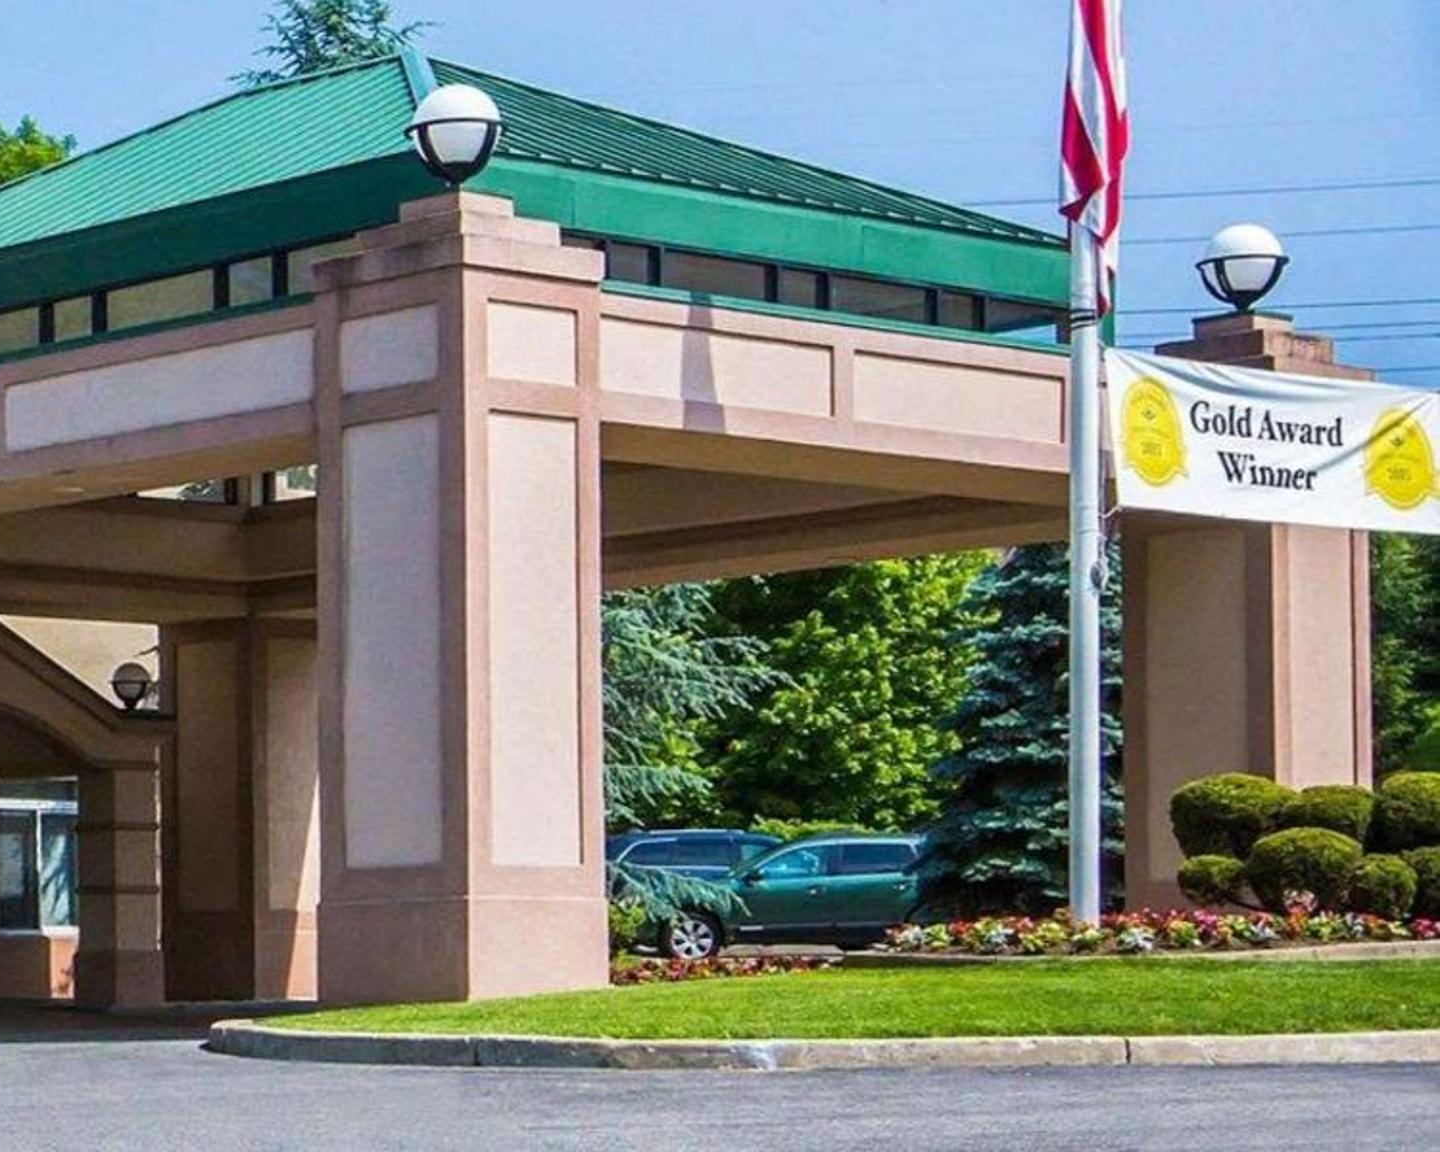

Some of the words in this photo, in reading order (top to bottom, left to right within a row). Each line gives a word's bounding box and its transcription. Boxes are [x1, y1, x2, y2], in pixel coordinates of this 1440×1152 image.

[1190, 400, 1252, 438] Gold
[1258, 410, 1344, 447] Award
[1217, 451, 1318, 491] Winner
